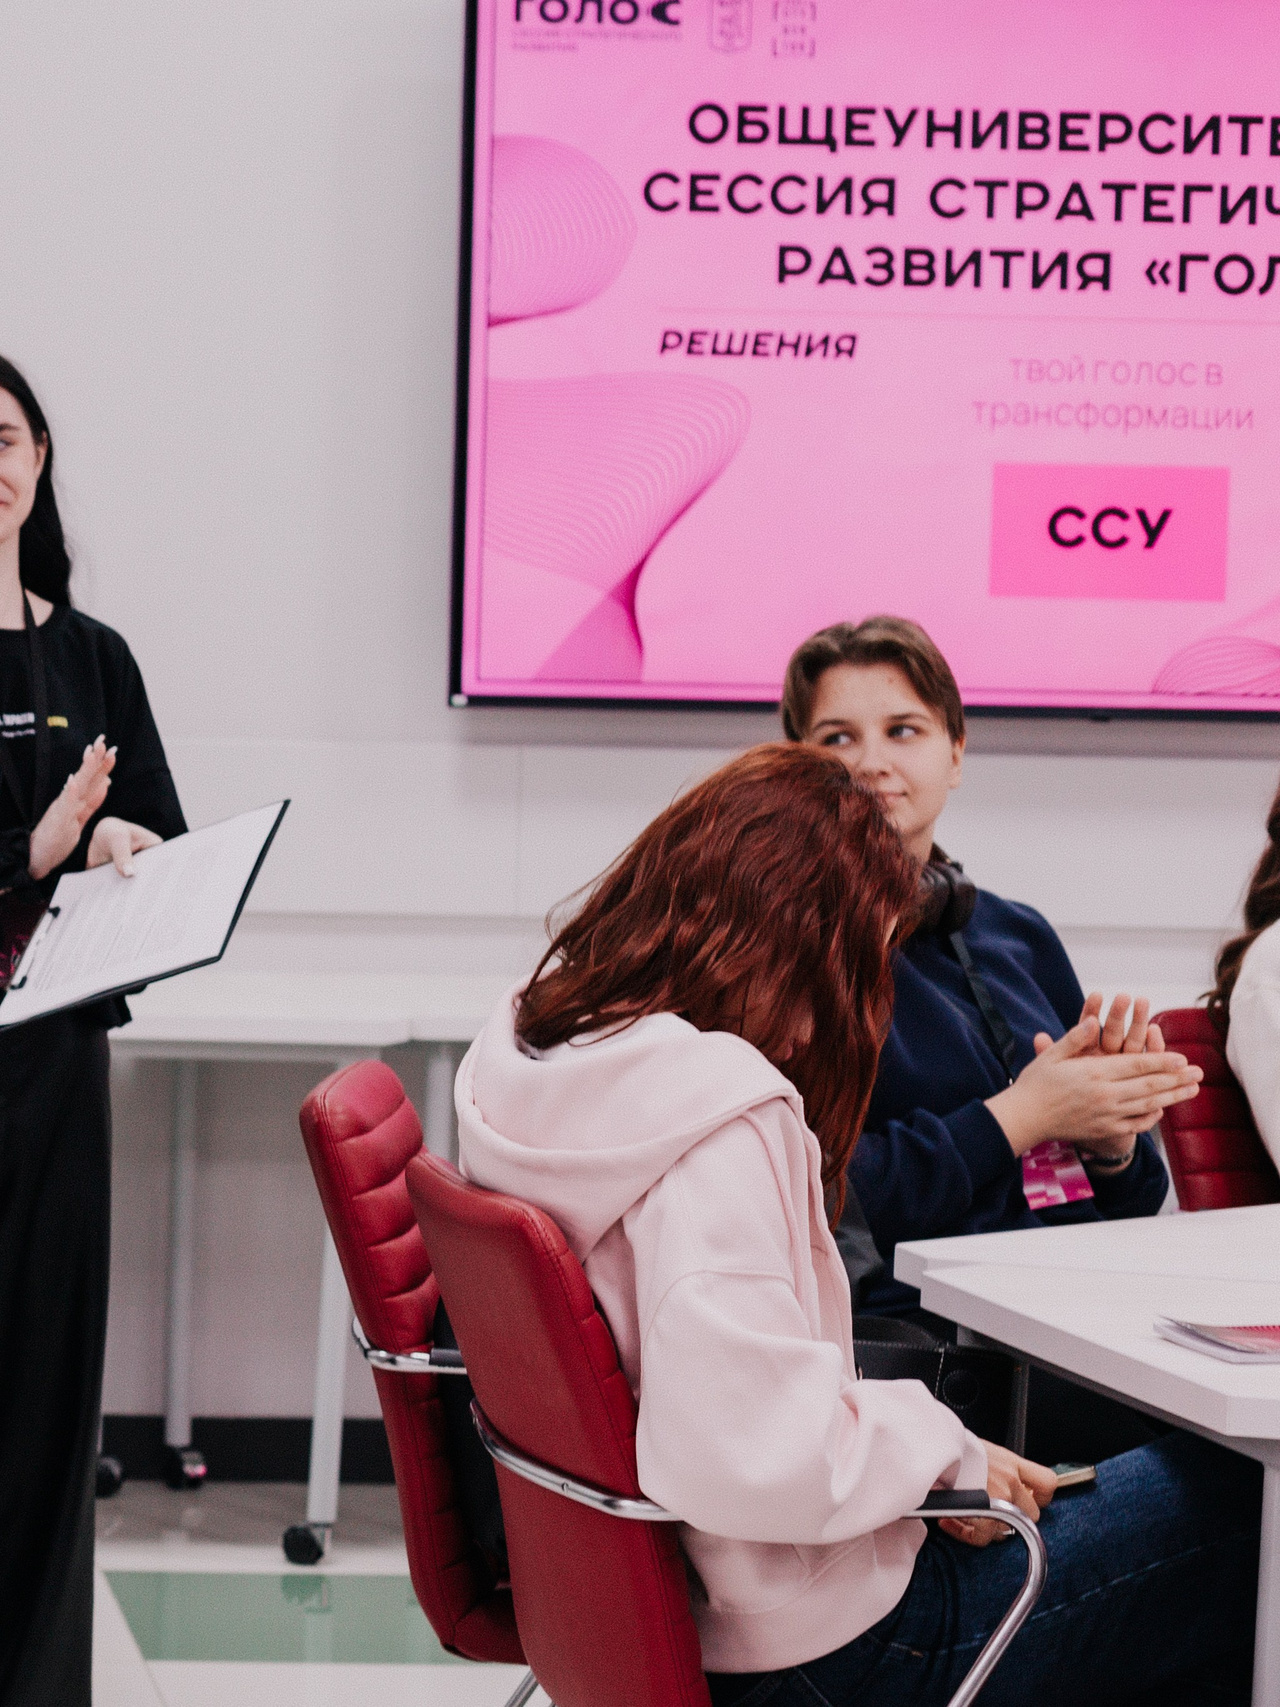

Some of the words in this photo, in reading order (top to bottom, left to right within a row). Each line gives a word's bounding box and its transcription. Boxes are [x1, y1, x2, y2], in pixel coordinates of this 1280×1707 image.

[644, 172, 896, 216] СЕССИЯ
[778, 245, 1111, 291] РАЗВИТИЯ
[660, 330, 858, 358] РЕШЕНИЯ
[1094, 359, 1197, 387] голос
[1205, 363, 1224, 386] в
[972, 400, 1255, 435] трансформации
[1048, 505, 1173, 550] ССУ
